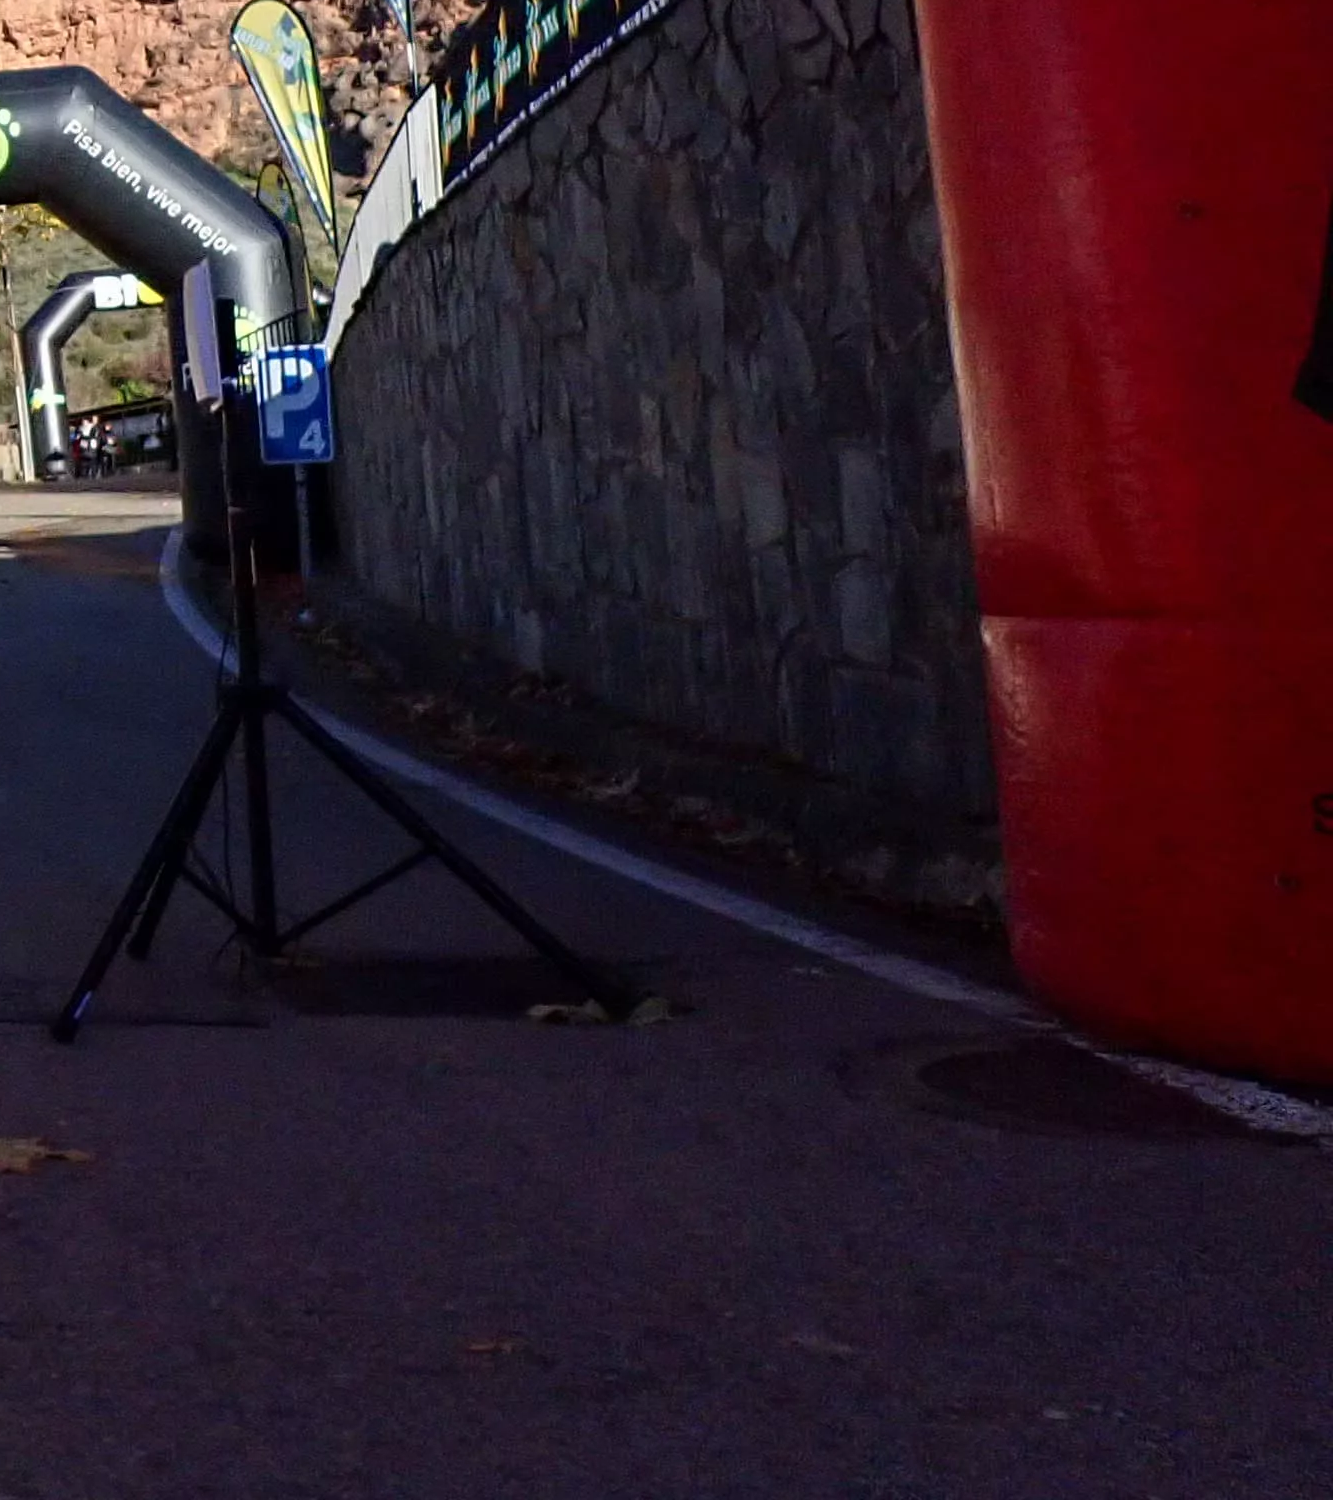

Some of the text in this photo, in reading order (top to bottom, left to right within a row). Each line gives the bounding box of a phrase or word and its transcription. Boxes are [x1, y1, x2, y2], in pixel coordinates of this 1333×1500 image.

[63, 118, 238, 256] Pisa bien, vive mejor
[262, 357, 321, 438] P
[298, 418, 326, 455] 4
